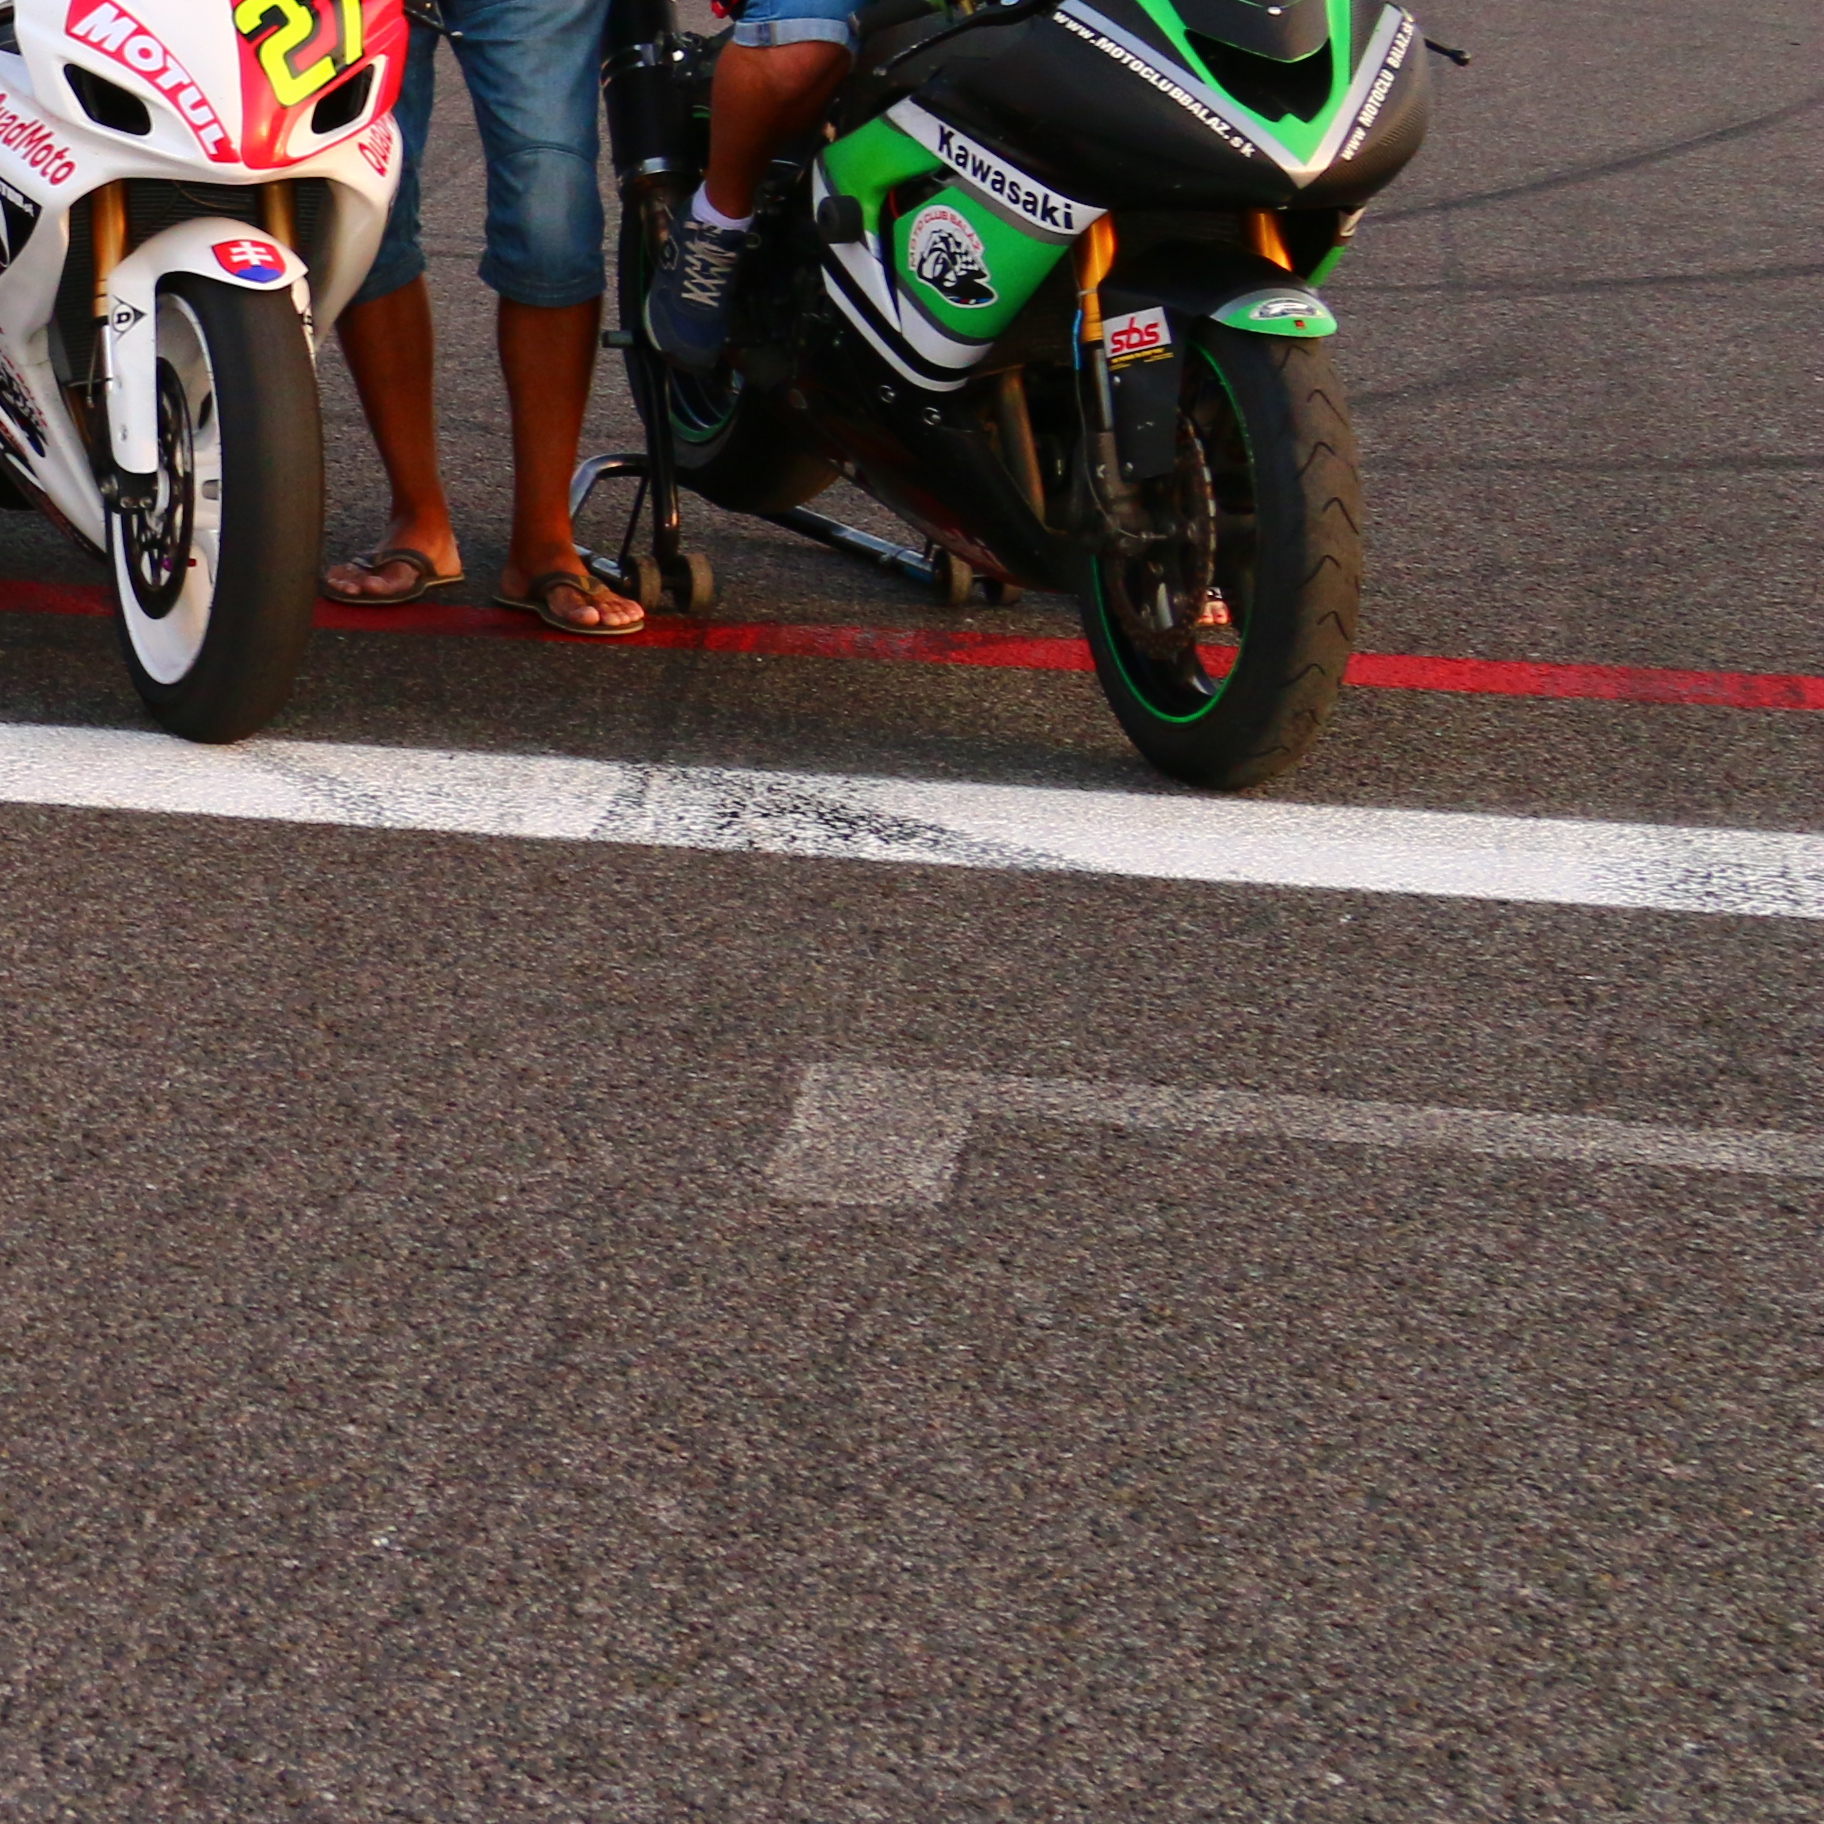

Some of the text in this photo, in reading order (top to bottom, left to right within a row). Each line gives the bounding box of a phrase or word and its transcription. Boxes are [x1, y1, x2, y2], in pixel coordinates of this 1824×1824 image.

[75, 2, 224, 159] MOTUL
[937, 124, 1074, 230] Kawasaki
[909, 210, 982, 268] MOTO CLUB BALAZ
[1110, 315, 1160, 354] sbs
